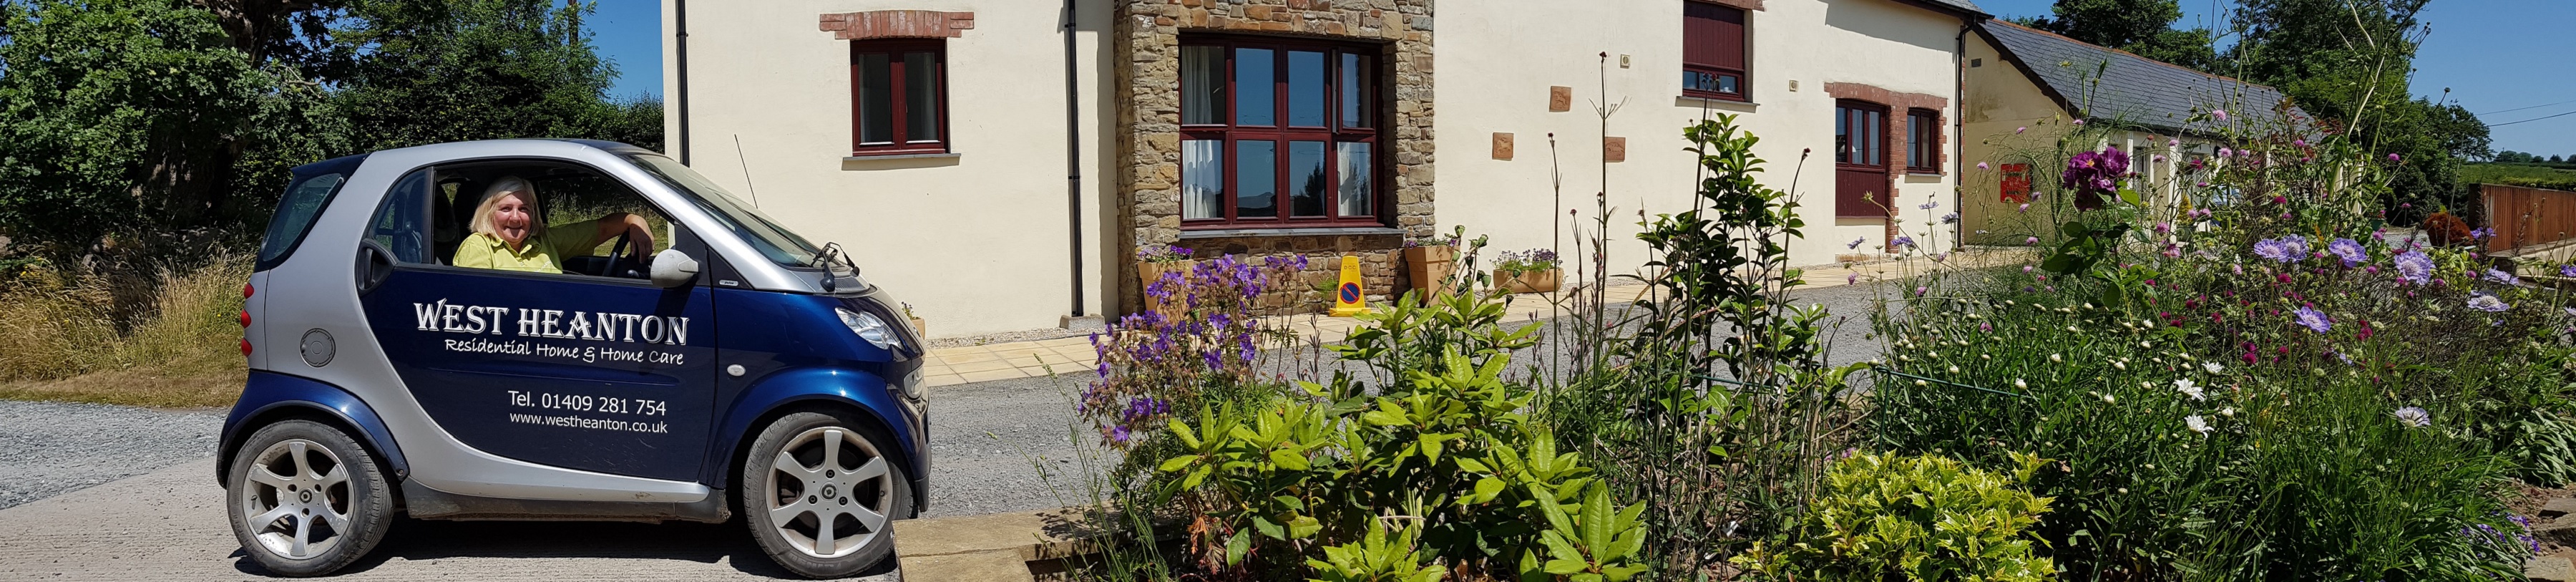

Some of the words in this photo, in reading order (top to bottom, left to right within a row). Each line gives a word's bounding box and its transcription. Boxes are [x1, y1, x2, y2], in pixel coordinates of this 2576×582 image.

[414, 298, 509, 336] WEST
[517, 309, 690, 345] HEANTON
[445, 338, 531, 356] Residential
[536, 344, 579, 357] Home
[583, 346, 595, 364] &
[600, 347, 644, 363] Home
[649, 351, 684, 365] Care
[508, 391, 535, 407] Tel.
[542, 393, 592, 412] 01409
[599, 397, 628, 413] 281
[636, 399, 667, 417] 754
[509, 413, 668, 434] www.westheanton.co.uk
